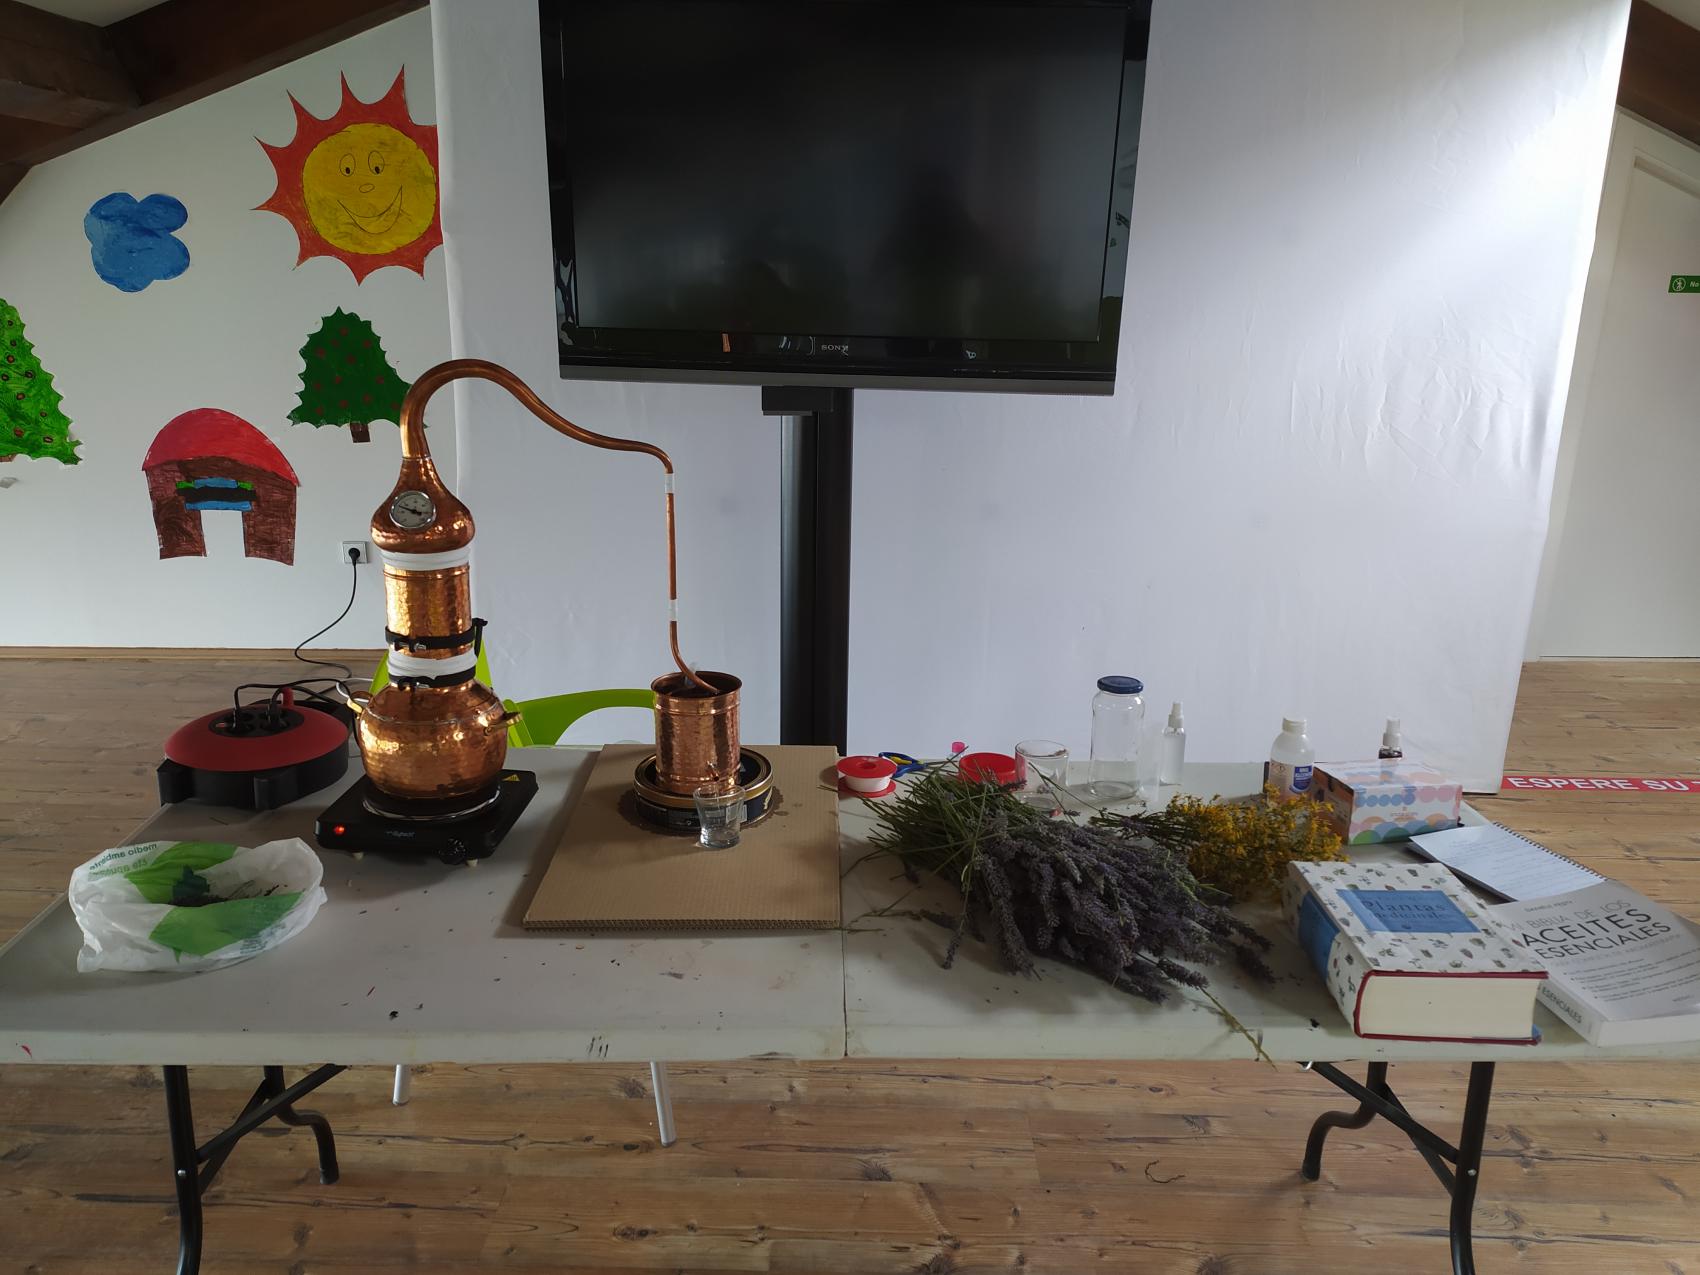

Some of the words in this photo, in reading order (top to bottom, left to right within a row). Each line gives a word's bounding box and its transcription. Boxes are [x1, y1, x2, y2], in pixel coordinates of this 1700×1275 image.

[821, 344, 848, 352] SONY
[1507, 777, 1639, 790] ESPERE
[1642, 779, 1690, 791] SU
[1361, 900, 1446, 911] Plantas
[1526, 914, 1571, 929] BIBLIA
[1573, 909, 1600, 920] DE
[1600, 900, 1631, 913] LOS
[1521, 908, 1652, 947] ACEITES
[1534, 922, 1672, 960] ESENCIALES
[1542, 986, 1583, 1024] ESENCIALES
